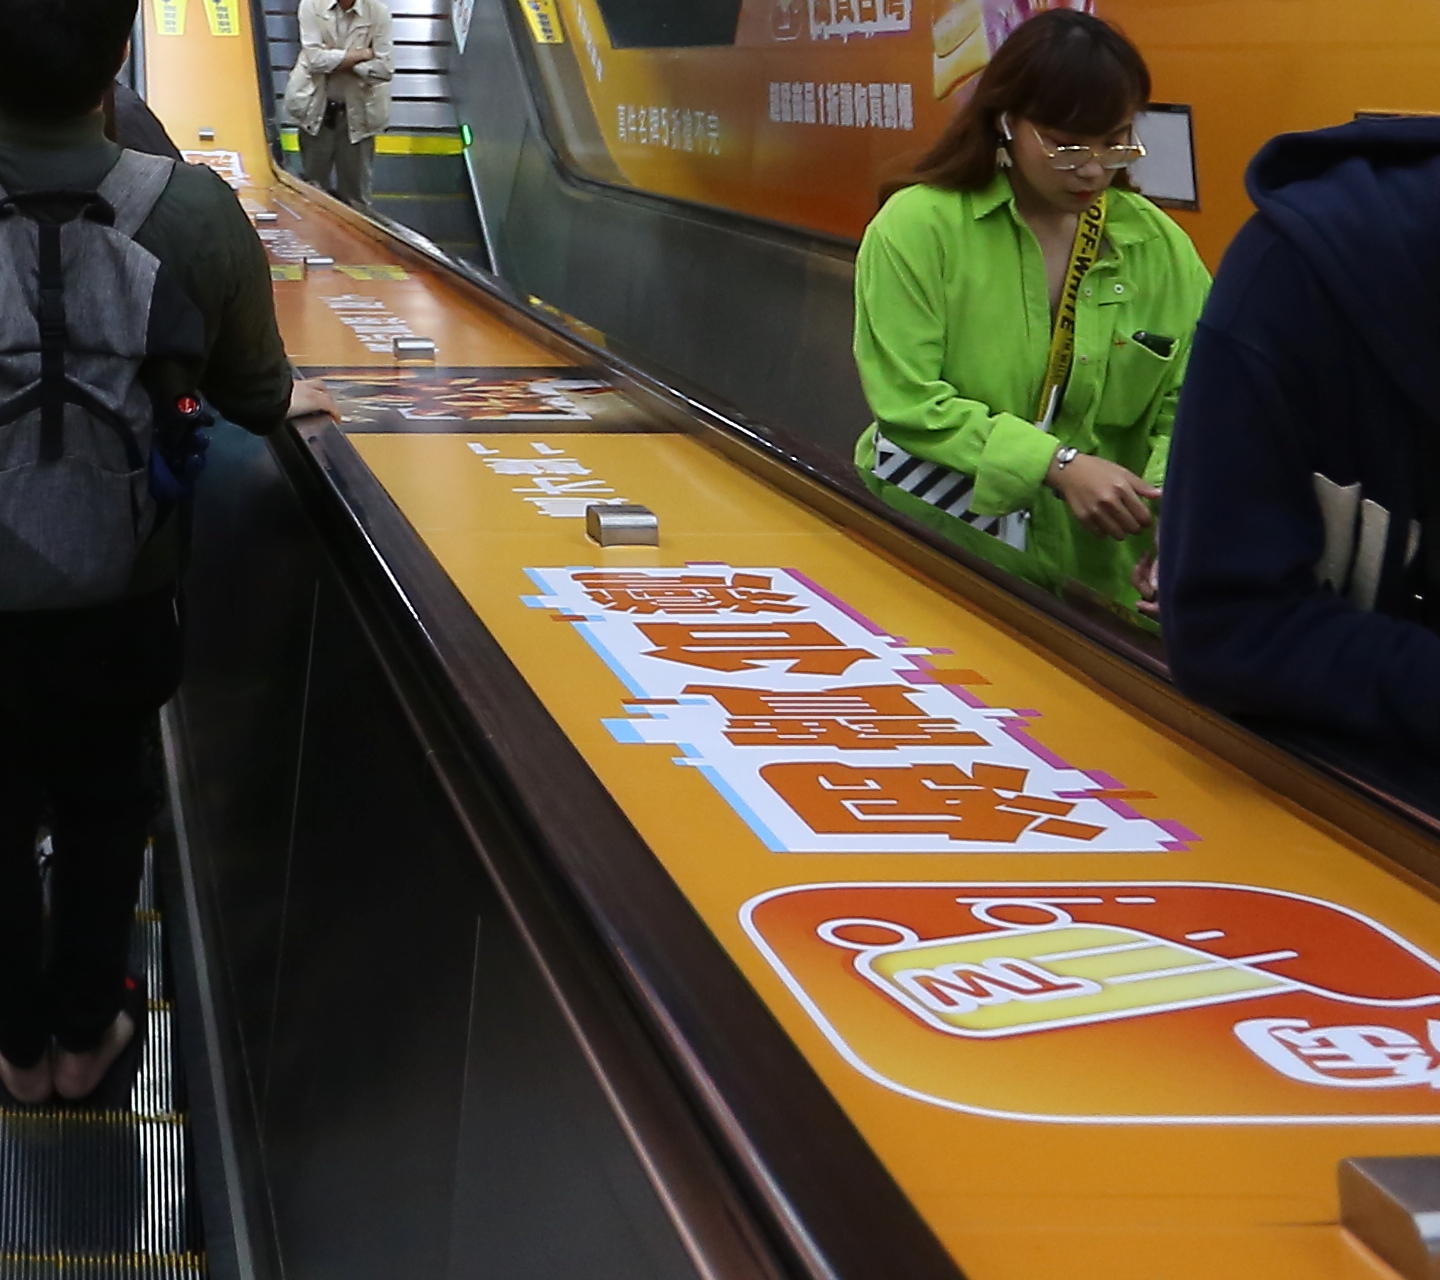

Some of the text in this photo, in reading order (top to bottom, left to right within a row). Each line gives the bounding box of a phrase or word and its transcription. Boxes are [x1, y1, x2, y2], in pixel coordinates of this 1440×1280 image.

[572, 569, 1107, 843] 淘寶台灣
[896, 960, 1101, 1010] TW
